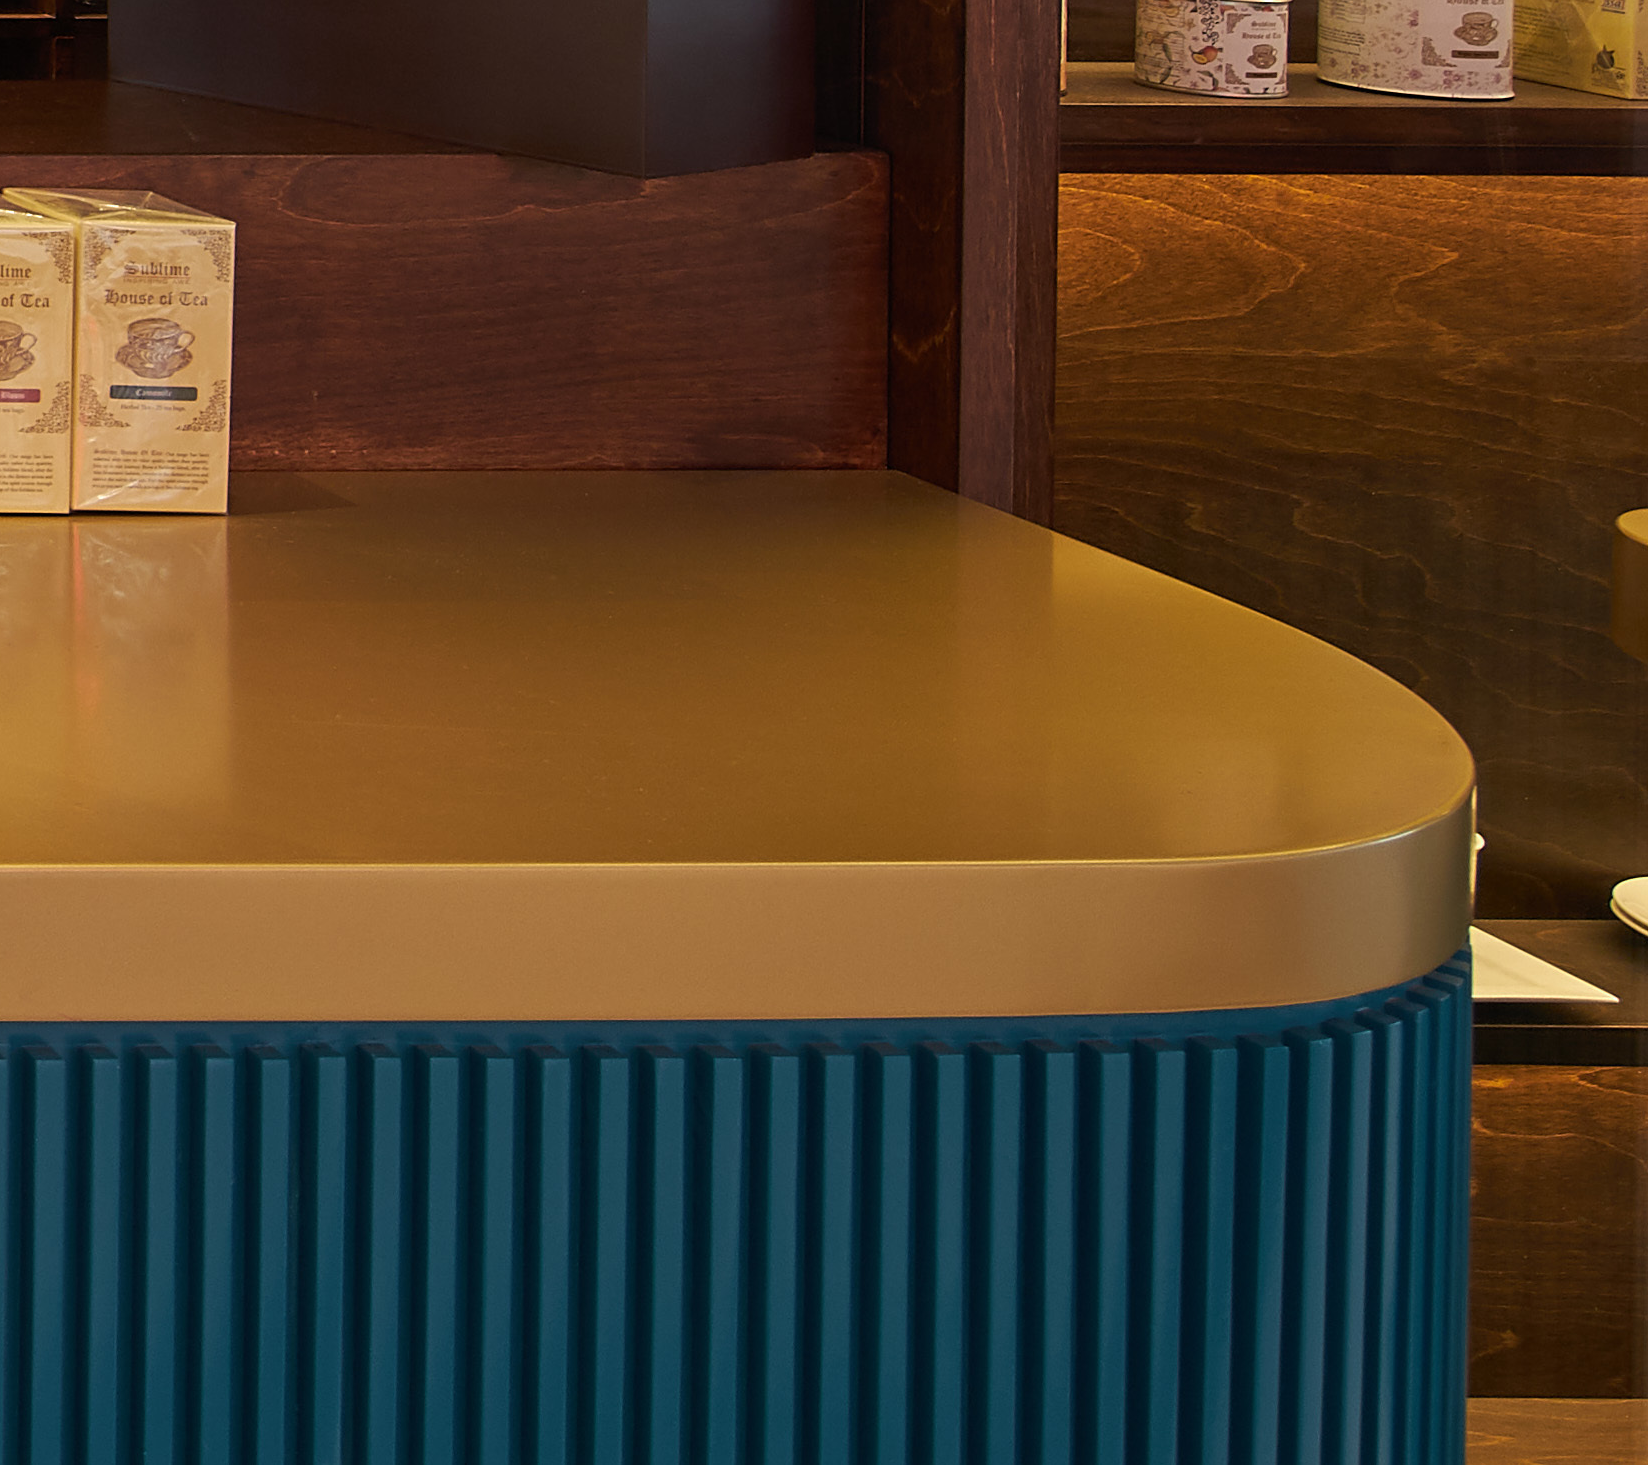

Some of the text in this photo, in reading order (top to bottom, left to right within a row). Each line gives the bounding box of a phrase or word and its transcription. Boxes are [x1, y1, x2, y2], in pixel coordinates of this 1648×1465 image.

[123, 261, 191, 276] Sublime
[1, 293, 15, 307] of
[21, 293, 51, 307] Tea
[105, 289, 210, 306] House of Tea
